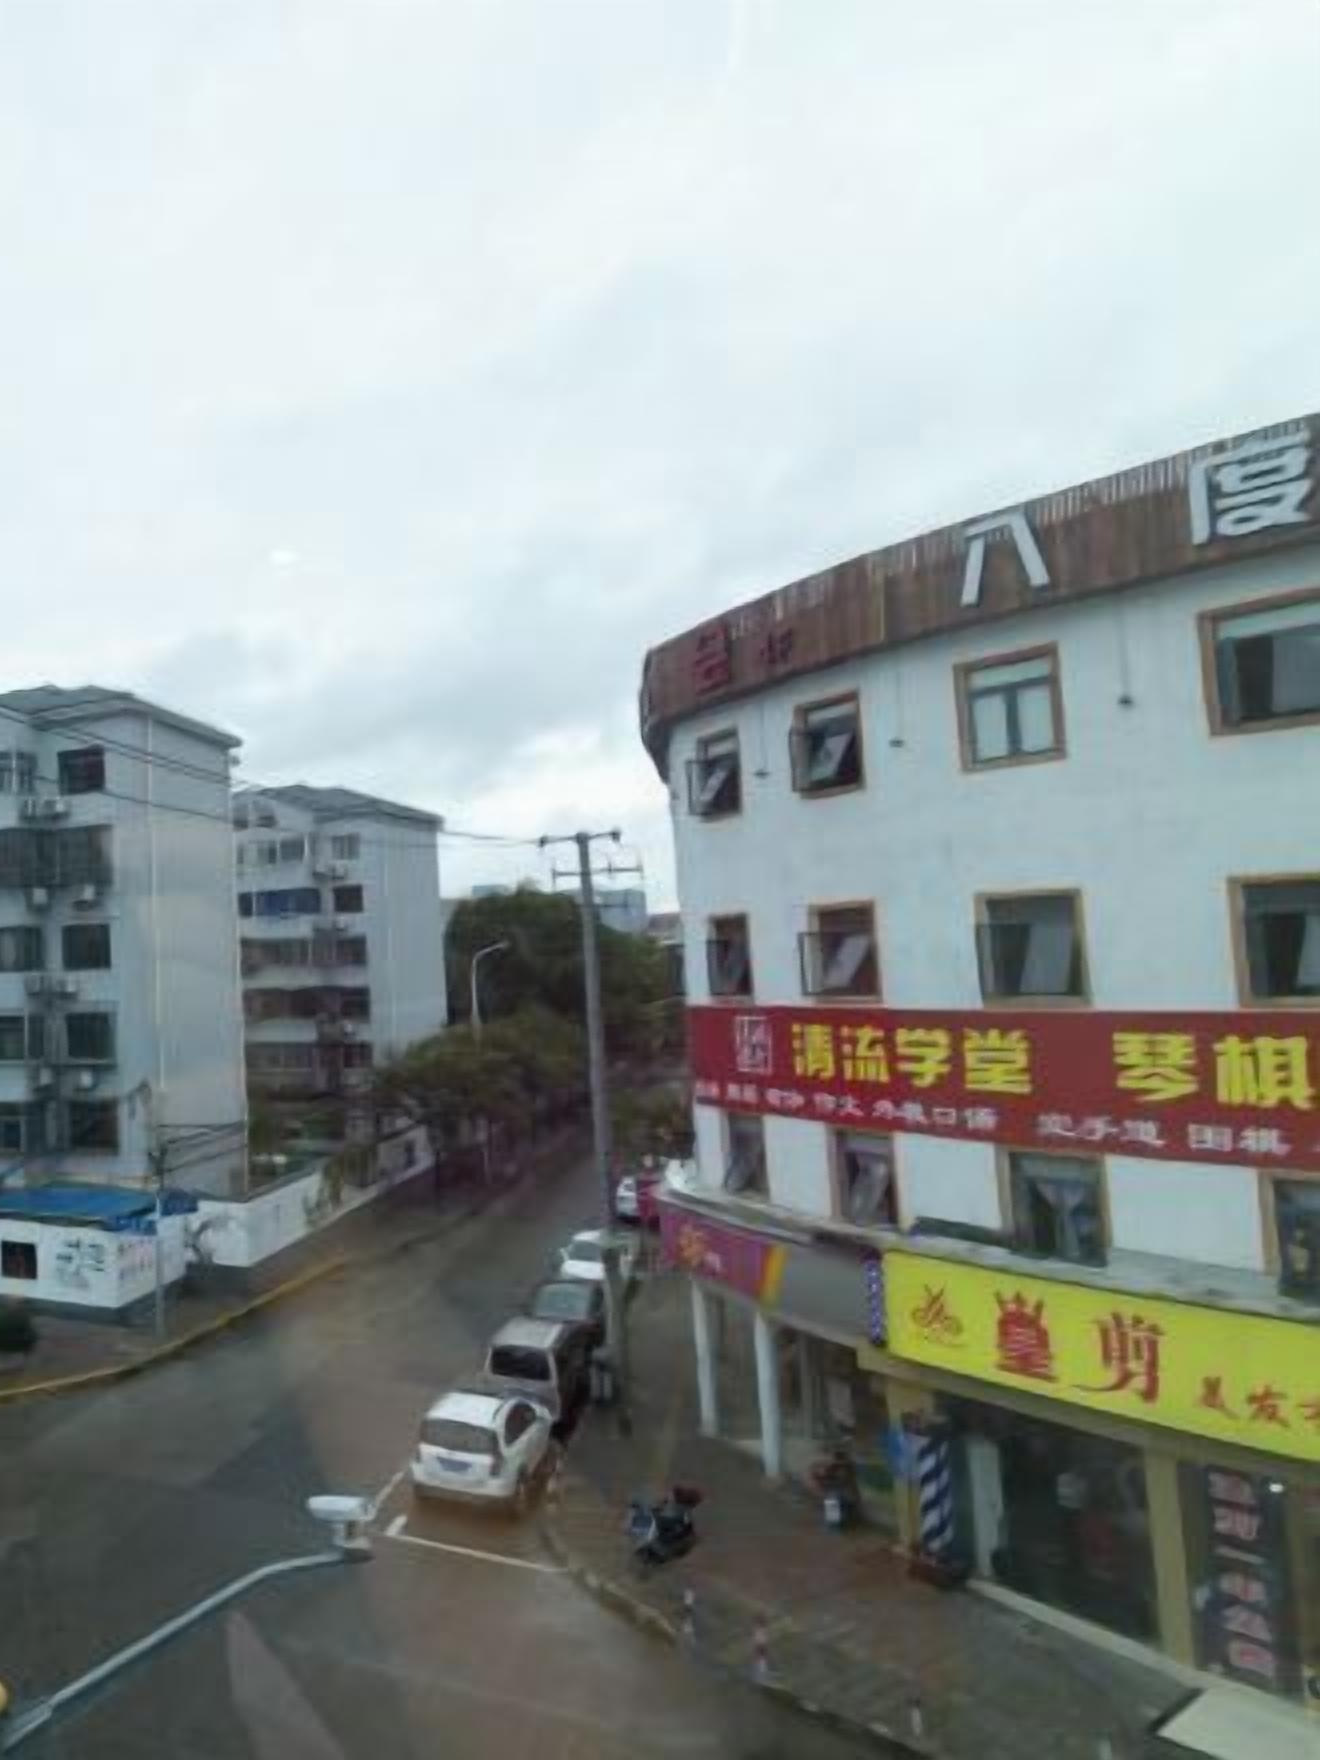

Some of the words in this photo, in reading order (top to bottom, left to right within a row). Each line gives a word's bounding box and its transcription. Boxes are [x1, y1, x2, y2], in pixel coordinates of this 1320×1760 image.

[791, 1022, 1032, 1095] 清流学堂
[1111, 1031, 1315, 1109] 琴棋
